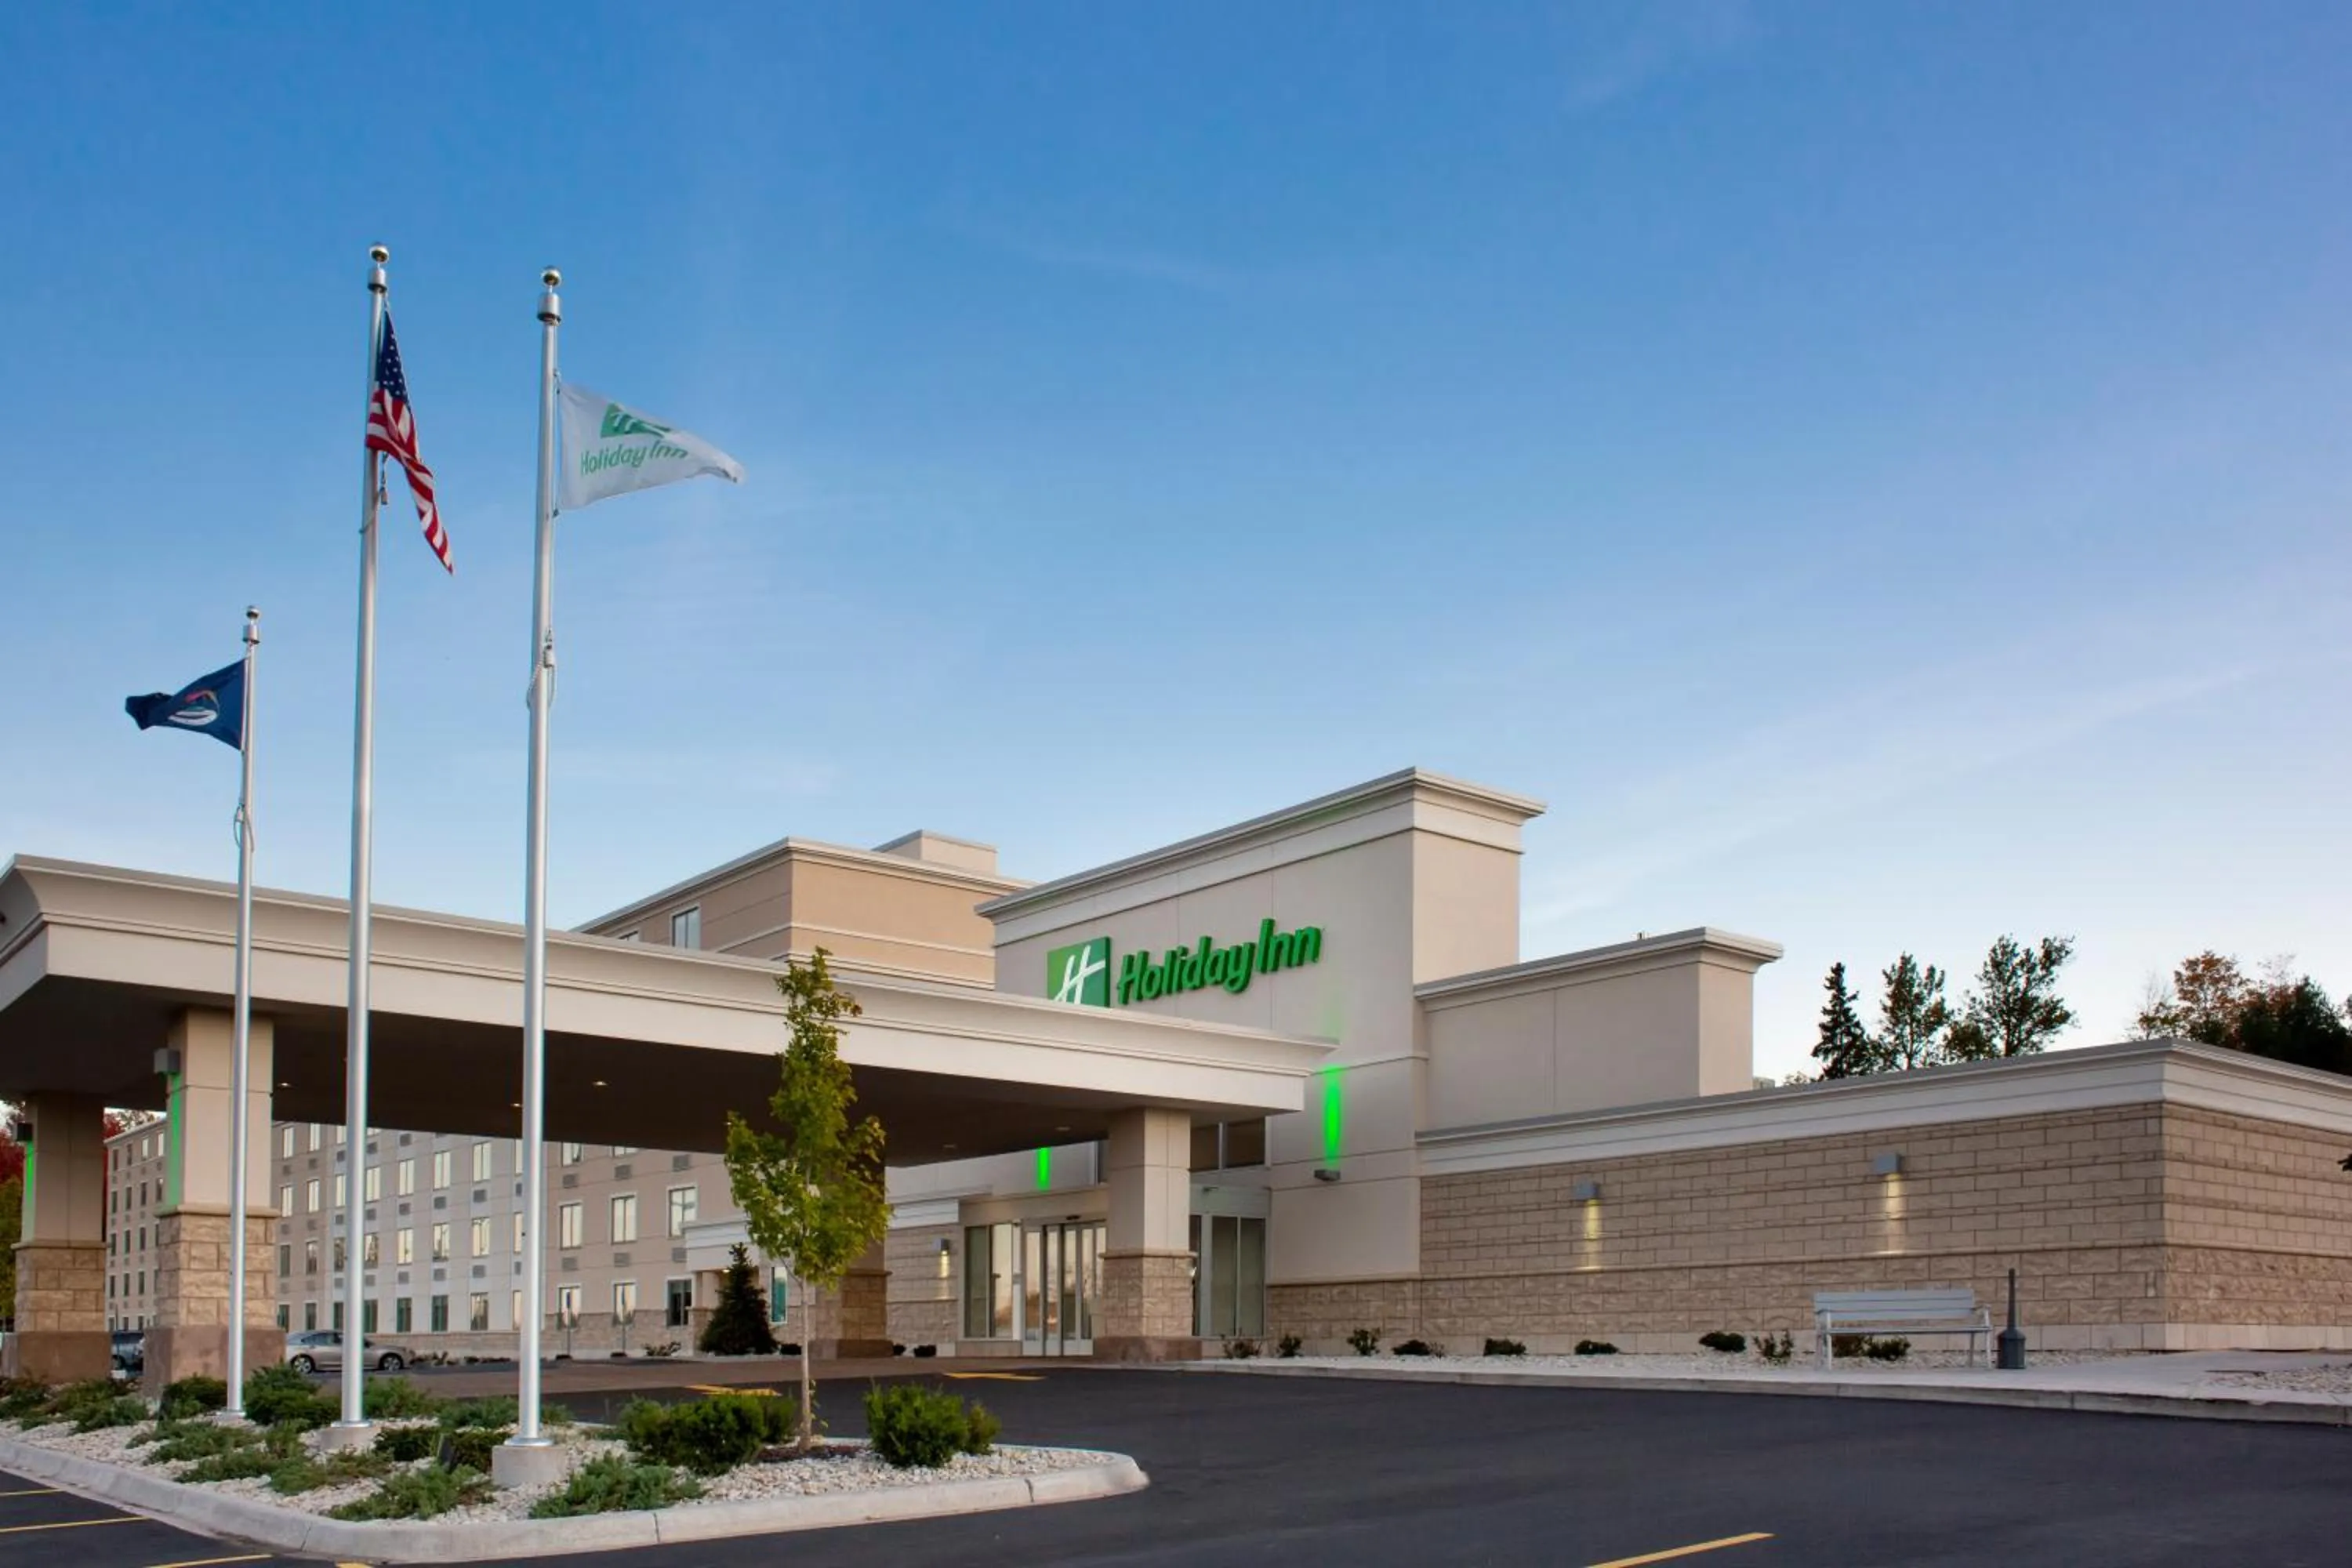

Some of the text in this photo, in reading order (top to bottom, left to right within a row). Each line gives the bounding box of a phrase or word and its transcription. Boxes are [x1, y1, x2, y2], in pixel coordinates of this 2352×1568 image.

[581, 439, 688, 475] Holiday Inn
[1054, 945, 1105, 1004] H
[1117, 918, 1322, 1004] Holiday Inn
